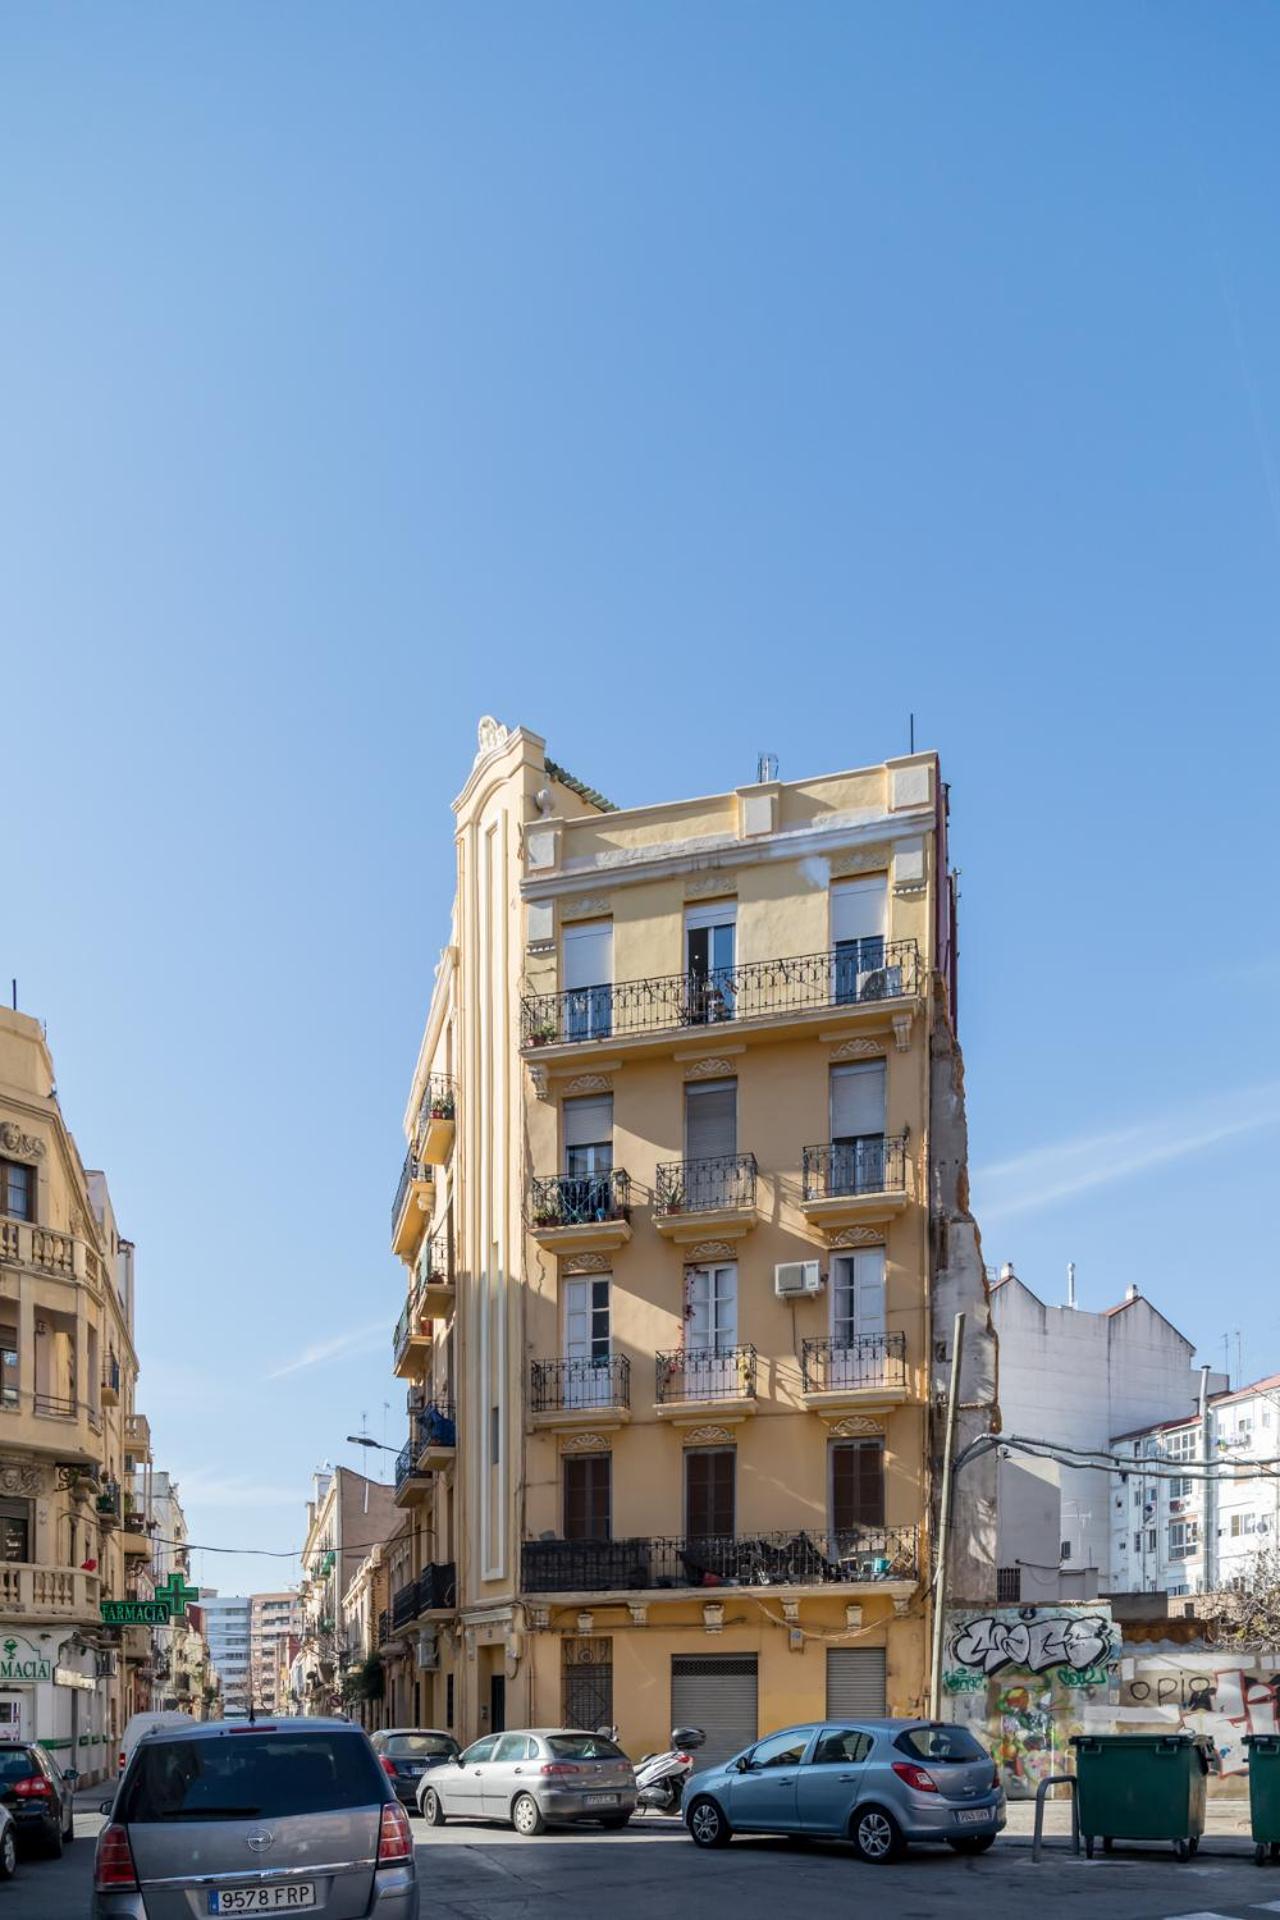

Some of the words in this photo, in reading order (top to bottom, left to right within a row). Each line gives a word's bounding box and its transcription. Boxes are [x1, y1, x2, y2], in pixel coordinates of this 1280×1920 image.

[102, 1605, 165, 1621] FARMACIA
[0, 1660, 47, 1678] MACIA
[222, 1889, 269, 1909] 9578
[274, 1886, 310, 1904] FRP
